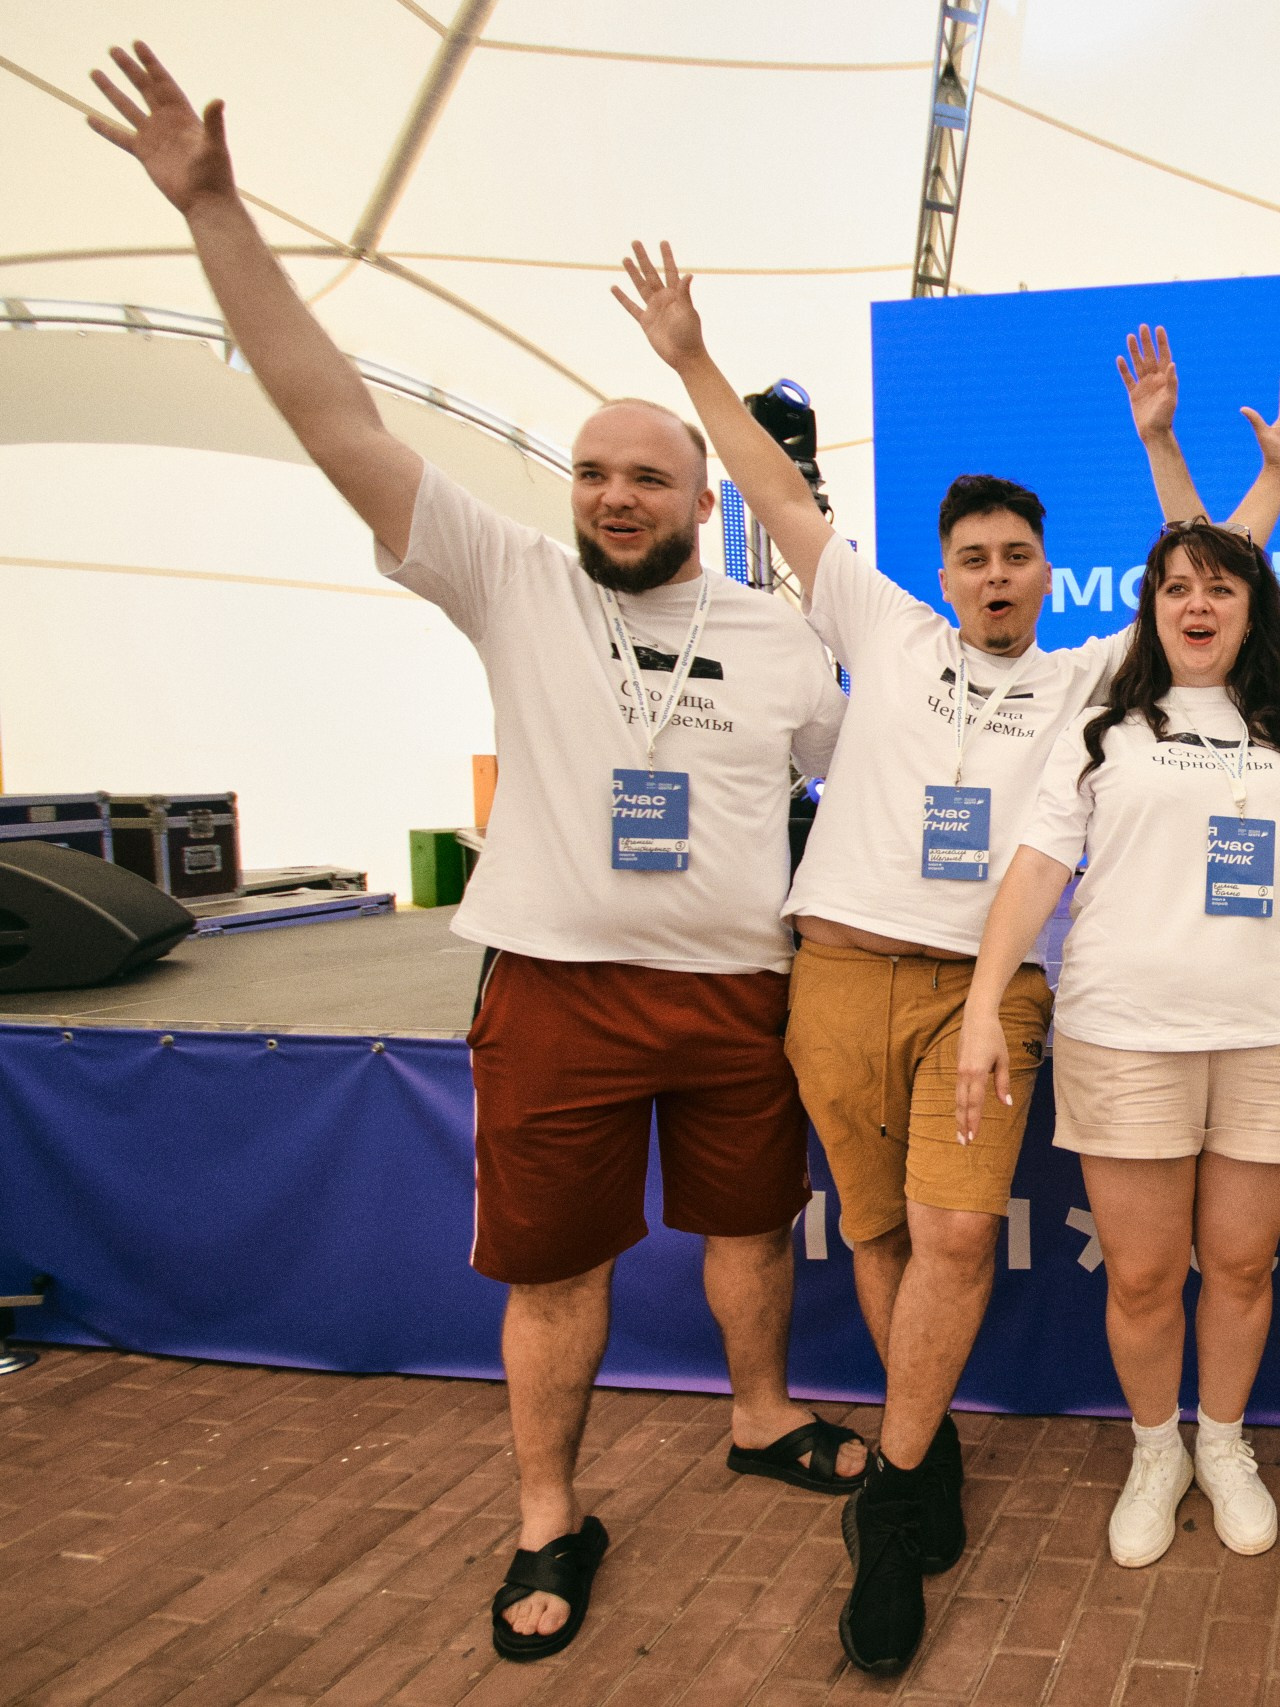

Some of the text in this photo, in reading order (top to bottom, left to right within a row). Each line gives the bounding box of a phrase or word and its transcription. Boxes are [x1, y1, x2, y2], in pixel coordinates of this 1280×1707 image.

[612, 793, 666, 806] учас
[612, 808, 666, 819] тник
[924, 808, 971, 819] учас
[923, 821, 970, 832] тник
[1208, 840, 1255, 852] учас
[1207, 853, 1254, 865] тник
